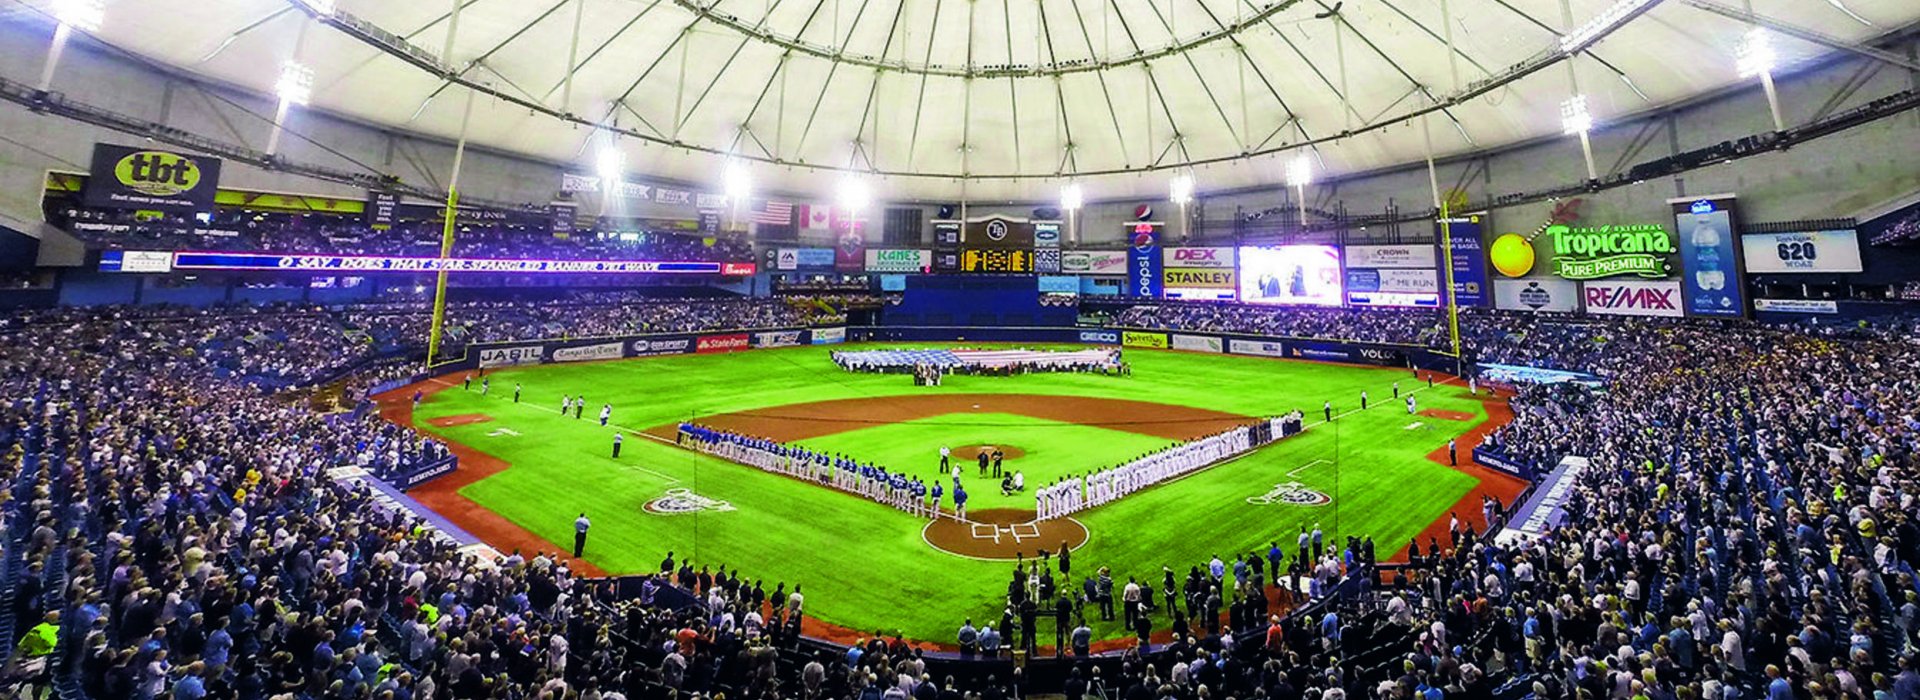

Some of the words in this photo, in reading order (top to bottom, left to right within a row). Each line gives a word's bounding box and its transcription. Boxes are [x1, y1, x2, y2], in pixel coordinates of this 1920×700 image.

[130, 154, 190, 185] tbt
[1546, 224, 1671, 257] Tropicana
[1036, 250, 1060, 262] ROSE
[1174, 249, 1217, 260] DEX
[1777, 242, 1816, 260] 620
[278, 257, 293, 267] O
[340, 257, 384, 269] DOES
[388, 258, 424, 269] THAT
[547, 261, 598, 272] BANNER
[601, 261, 624, 272] YET
[624, 262, 659, 273] WAVE
[1562, 263, 1594, 275] PURE
[1595, 258, 1655, 273] PREMIUM
[1137, 256, 1152, 296] pepsi
[1166, 272, 1231, 284] STANLEY
[1586, 286, 1676, 310] RE/MAX
[1081, 332, 1117, 342] GEICO
[482, 348, 541, 361] JABIL
